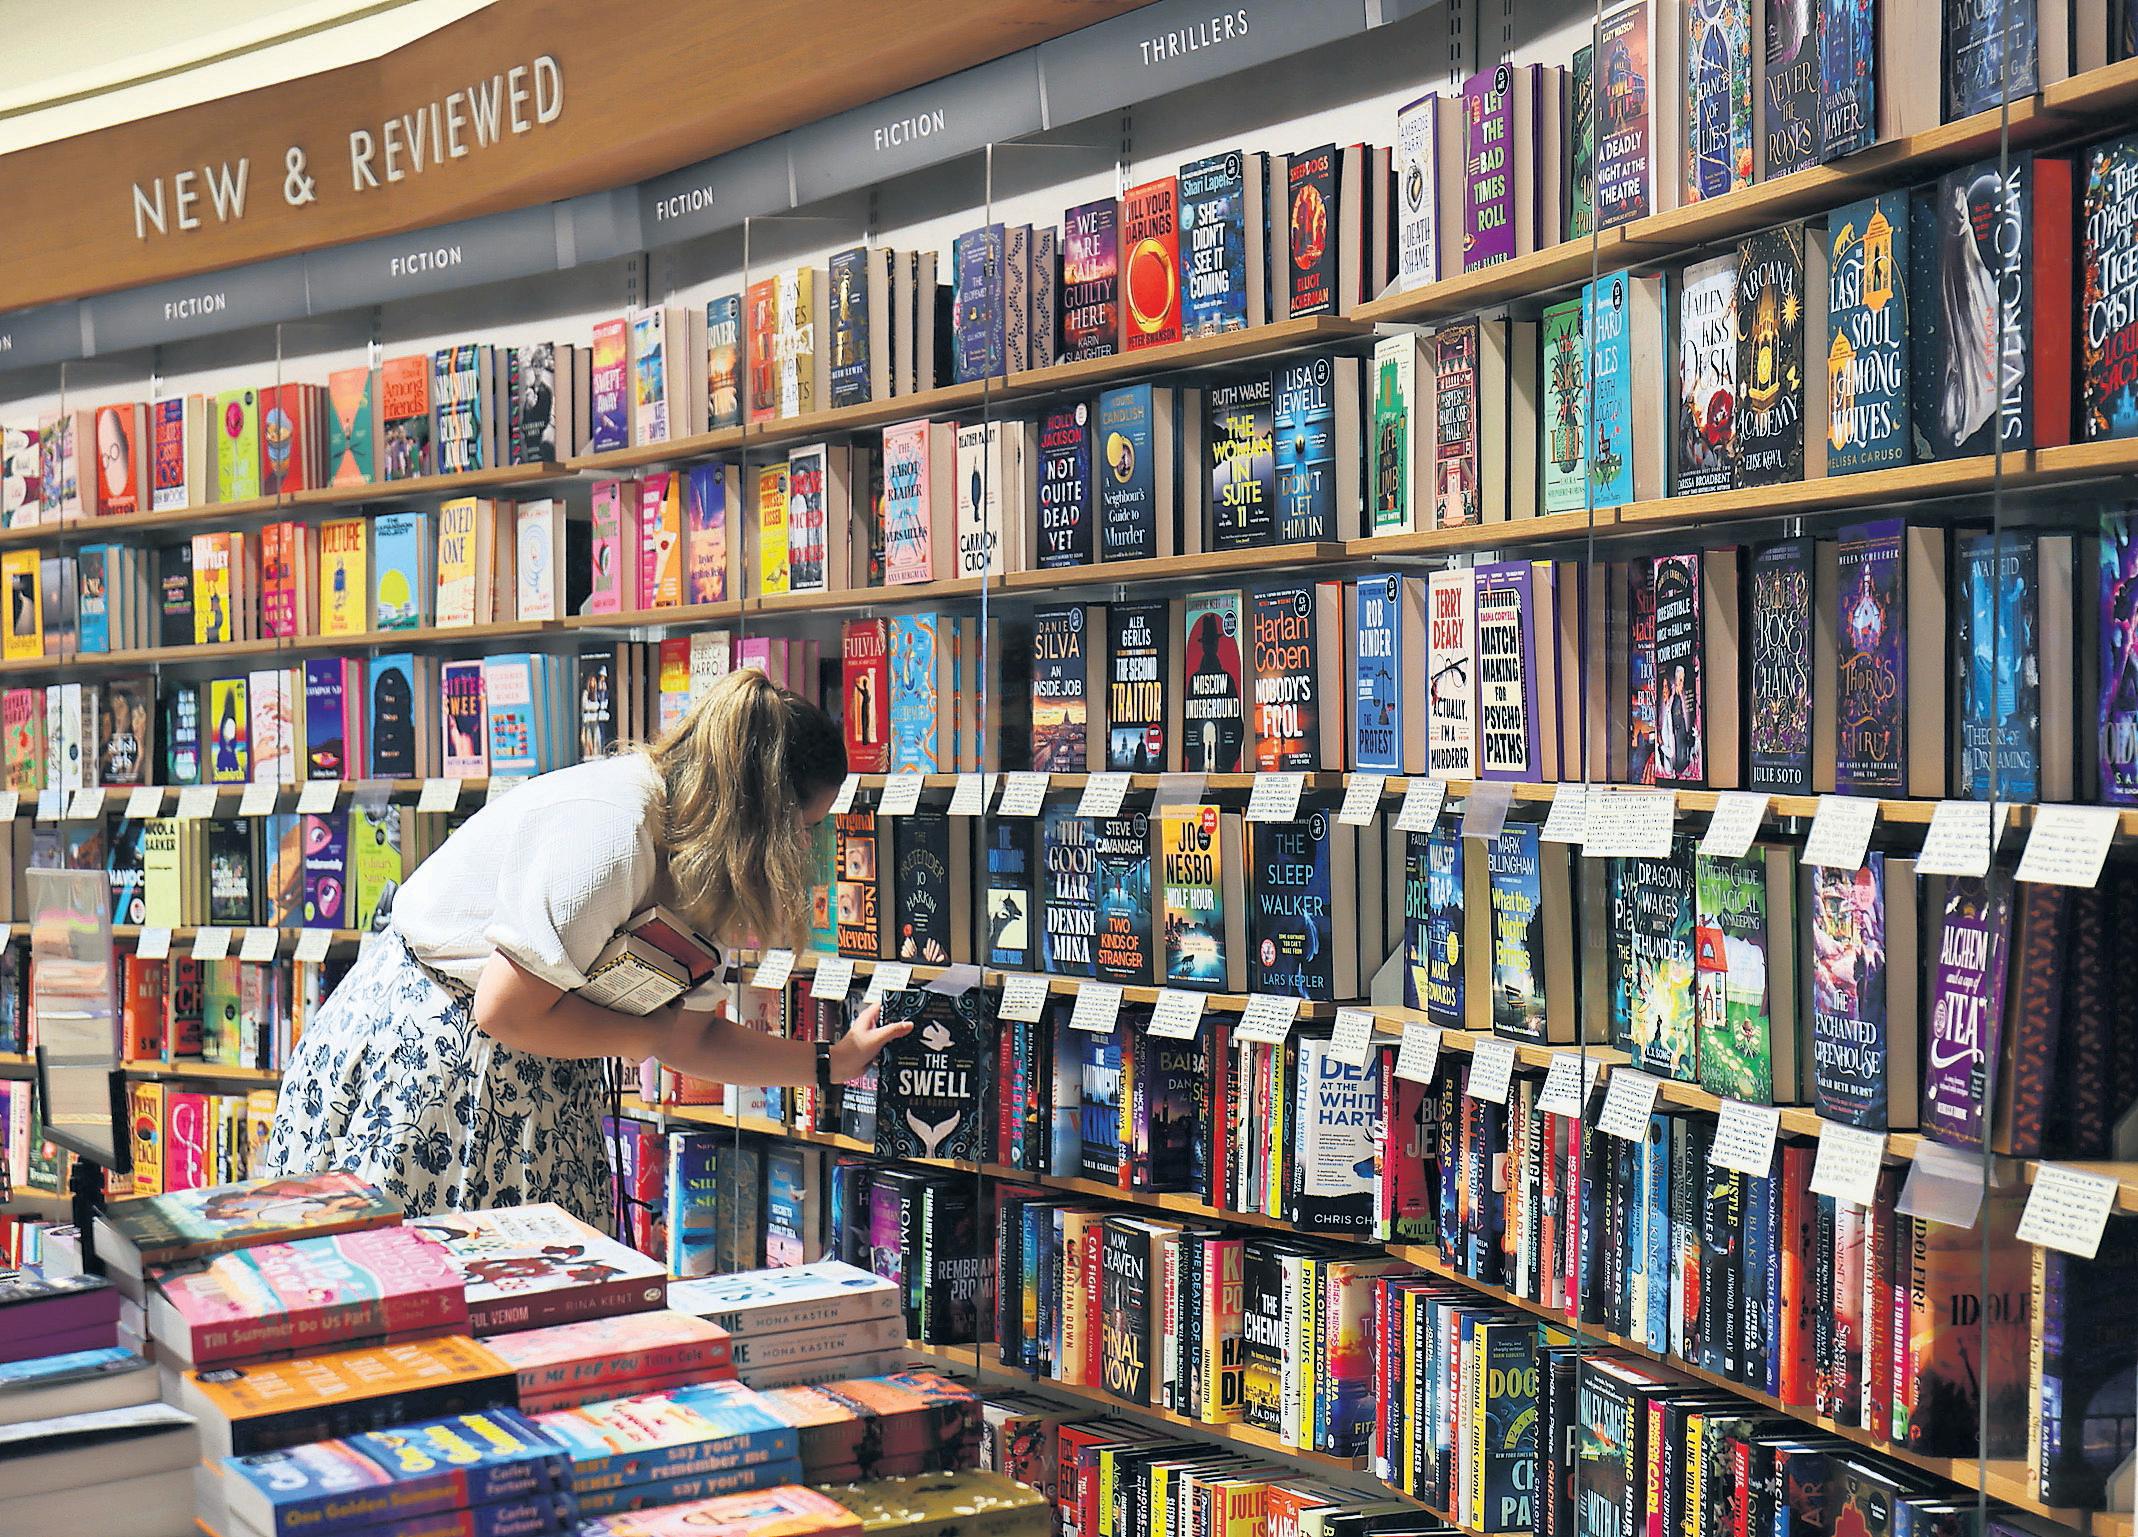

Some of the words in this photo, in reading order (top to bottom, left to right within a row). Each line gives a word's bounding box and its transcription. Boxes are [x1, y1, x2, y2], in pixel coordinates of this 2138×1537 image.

[1139, 8, 1250, 67] THRILLERS
[1699, 75, 1730, 100] DANCE
[1766, 61, 1817, 110] NEVER
[873, 108, 947, 151] FICTION
[1482, 117, 1504, 145] THE
[1824, 103, 1866, 142] MAYER
[132, 157, 250, 239] NEW
[283, 146, 316, 206] &
[349, 54, 565, 191] REVIEWED
[1606, 131, 1643, 159] DEADLY
[1768, 119, 1813, 165] ROSES
[1480, 147, 1504, 174] BAD
[1631, 157, 1645, 173] THE
[1183, 177, 1203, 198] Shari
[1473, 175, 1505, 204] TIMES
[1600, 177, 1641, 204] THEATRE
[656, 185, 715, 222] FICTION
[1145, 191, 1171, 218] YOUR
[1198, 200, 1218, 225] SHE
[1077, 210, 1099, 235] WE
[1126, 214, 1172, 244] DARLINGS
[1478, 204, 1506, 232] ROLL
[1075, 235, 1100, 257] ARE
[1192, 222, 1225, 250] DIDN'T
[390, 245, 463, 277] FICTION
[1194, 249, 1213, 276] SEE
[1213, 246, 1225, 270] IT
[1404, 244, 1430, 274] SHAME
[1064, 279, 1113, 309] GUILTY
[1190, 270, 1229, 299] COMING
[1297, 272, 1320, 291] ELLIOT
[1742, 261, 1793, 305] ARCANA
[1830, 258, 1865, 314] LAST
[164, 292, 227, 320] FICTION
[1994, 165, 2023, 440] SILVERCLOAK
[1071, 303, 1106, 331] HERE
[1851, 307, 1900, 349] SOUL
[383, 379, 424, 398] Among
[593, 369, 622, 394] SWEPT
[1286, 365, 1313, 390] LISA
[1837, 350, 1901, 406] AMONG
[1212, 386, 1238, 406] RUTH
[1240, 381, 1270, 401] WARE
[1276, 388, 1327, 416] JEWELL
[1226, 414, 1255, 438] THE
[1736, 394, 1799, 442] ACADEMY
[1833, 401, 1892, 447] WOLVES
[1212, 434, 1272, 463] WOMAN
[1860, 447, 1903, 463] CARUSO
[1047, 457, 1075, 480] NOT
[1233, 460, 1249, 482] IN
[1041, 479, 1082, 506] QUITE
[1222, 481, 1263, 507] SUITE
[1281, 471, 1322, 495] DON'T
[1104, 488, 1145, 507] Neighbour's
[1291, 496, 1312, 516] LET
[440, 506, 473, 536] LOVED
[1044, 504, 1079, 529] DEAD
[1109, 508, 1129, 524] Guide
[1282, 520, 1306, 540] HIM
[1308, 516, 1323, 536] IN
[320, 522, 361, 553] VULTURE
[443, 537, 467, 564] ONE
[1049, 529, 1073, 551] YET
[1105, 527, 1146, 547] Murder
[1365, 599, 1383, 626] ROB
[1435, 588, 1461, 619] TERRY
[1128, 616, 1144, 629] ALEX
[1254, 612, 1309, 642] Harlan
[1433, 619, 1464, 650] DEARY
[844, 637, 882, 659] FULVIA
[1035, 632, 1080, 659] SILVA
[1122, 628, 1151, 648] GERLIS
[1359, 628, 1392, 658] RINDER
[1481, 626, 1517, 655] MATCH
[1255, 644, 1310, 674] Coben
[1483, 658, 1518, 683] MAKING
[442, 678, 486, 695] BITTER
[1063, 681, 1082, 697] JOB
[1193, 673, 1228, 694] MOSCOW
[1255, 676, 1311, 704] NOBODY'S
[1495, 686, 1506, 702] FOR
[445, 697, 485, 717] SWEET
[1112, 682, 1161, 722] TRAITOR
[1185, 698, 1239, 720] UNDERGROUND
[1263, 703, 1303, 739] FOOL
[1485, 706, 1520, 730] PSYCHO
[1359, 729, 1393, 755] PROTEST
[1486, 733, 1523, 765] PATHS
[1754, 766, 1775, 783] JULIE
[1776, 767, 1802, 784] SOTO
[1106, 821, 1131, 838] STEVE
[1096, 839, 1143, 855] CAVANAGH
[1497, 835, 1520, 855] MARK
[1049, 847, 1096, 874] GOOD
[1167, 854, 1213, 885] NESBO
[1429, 844, 1455, 875] WASP
[1488, 853, 1536, 876] BILLINGHAM
[1055, 874, 1089, 900] LIAR
[1268, 864, 1314, 885] SLEEP
[1638, 862, 1682, 888] DRAGON
[1730, 866, 1759, 886] GUIDE
[907, 890, 937, 914] HARKIN
[1168, 886, 1189, 910] WOLF
[1190, 888, 1214, 911] HOUR
[1260, 895, 1324, 917] WALKER
[1492, 888, 1513, 911] What
[1642, 893, 1679, 919] WAKES
[1711, 883, 1759, 915] MAGICAL
[838, 926, 877, 951] Stevens
[1109, 918, 1130, 934] TWO
[1497, 913, 1528, 945] Night
[1053, 934, 1091, 963] MINA
[1099, 950, 1143, 968] STRANGER
[1635, 933, 1686, 962] THUNDER
[1263, 973, 1285, 986] LARS
[1288, 974, 1324, 988] KEPLER
[1815, 1015, 1877, 1045] ENCHANTED
[924, 1054, 948, 1069] THE
[1815, 1039, 1881, 1079] GREENHOUSE
[899, 1069, 970, 1098] SWELL
[1320, 1083, 1332, 1091] AT
[1336, 1083, 1358, 1092] THE
[1851, 1086, 1873, 1098] DURST
[1319, 1110, 1376, 1127] HART
[1445, 1124, 1453, 1168] STAR
[1530, 1120, 1540, 1186] MIRAGE
[900, 1198, 911, 1256] ROME
[1314, 1214, 1352, 1225] CHRIS
[1088, 1236, 1097, 1261] CAT
[1103, 1246, 1143, 1280] CRAVEN
[1614, 1229, 1623, 1306] ORDERS
[1911, 1218, 1927, 1315] IDOLFIRE
[1088, 1266, 1097, 1302] FIGHT
[1302, 1268, 1311, 1322] PRIVATE
[1727, 1267, 1735, 1308] LINWOOD
[491, 1307, 529, 1326] VENOM
[794, 1309, 839, 1323] KASTEN
[1262, 1293, 1278, 1316] THE
[232, 1321, 294, 1344] Summer
[342, 1310, 372, 1328] Part
[1726, 1310, 1734, 1352] BARCLAY
[1103, 1324, 1144, 1369] FINAL
[1302, 1328, 1310, 1364] LIVES
[1103, 1357, 1139, 1396] VOW
[1580, 1387, 1602, 1434] RILEY
[651, 1457, 734, 1480] remember
[1229, 1490, 1268, 1521] JULIE
